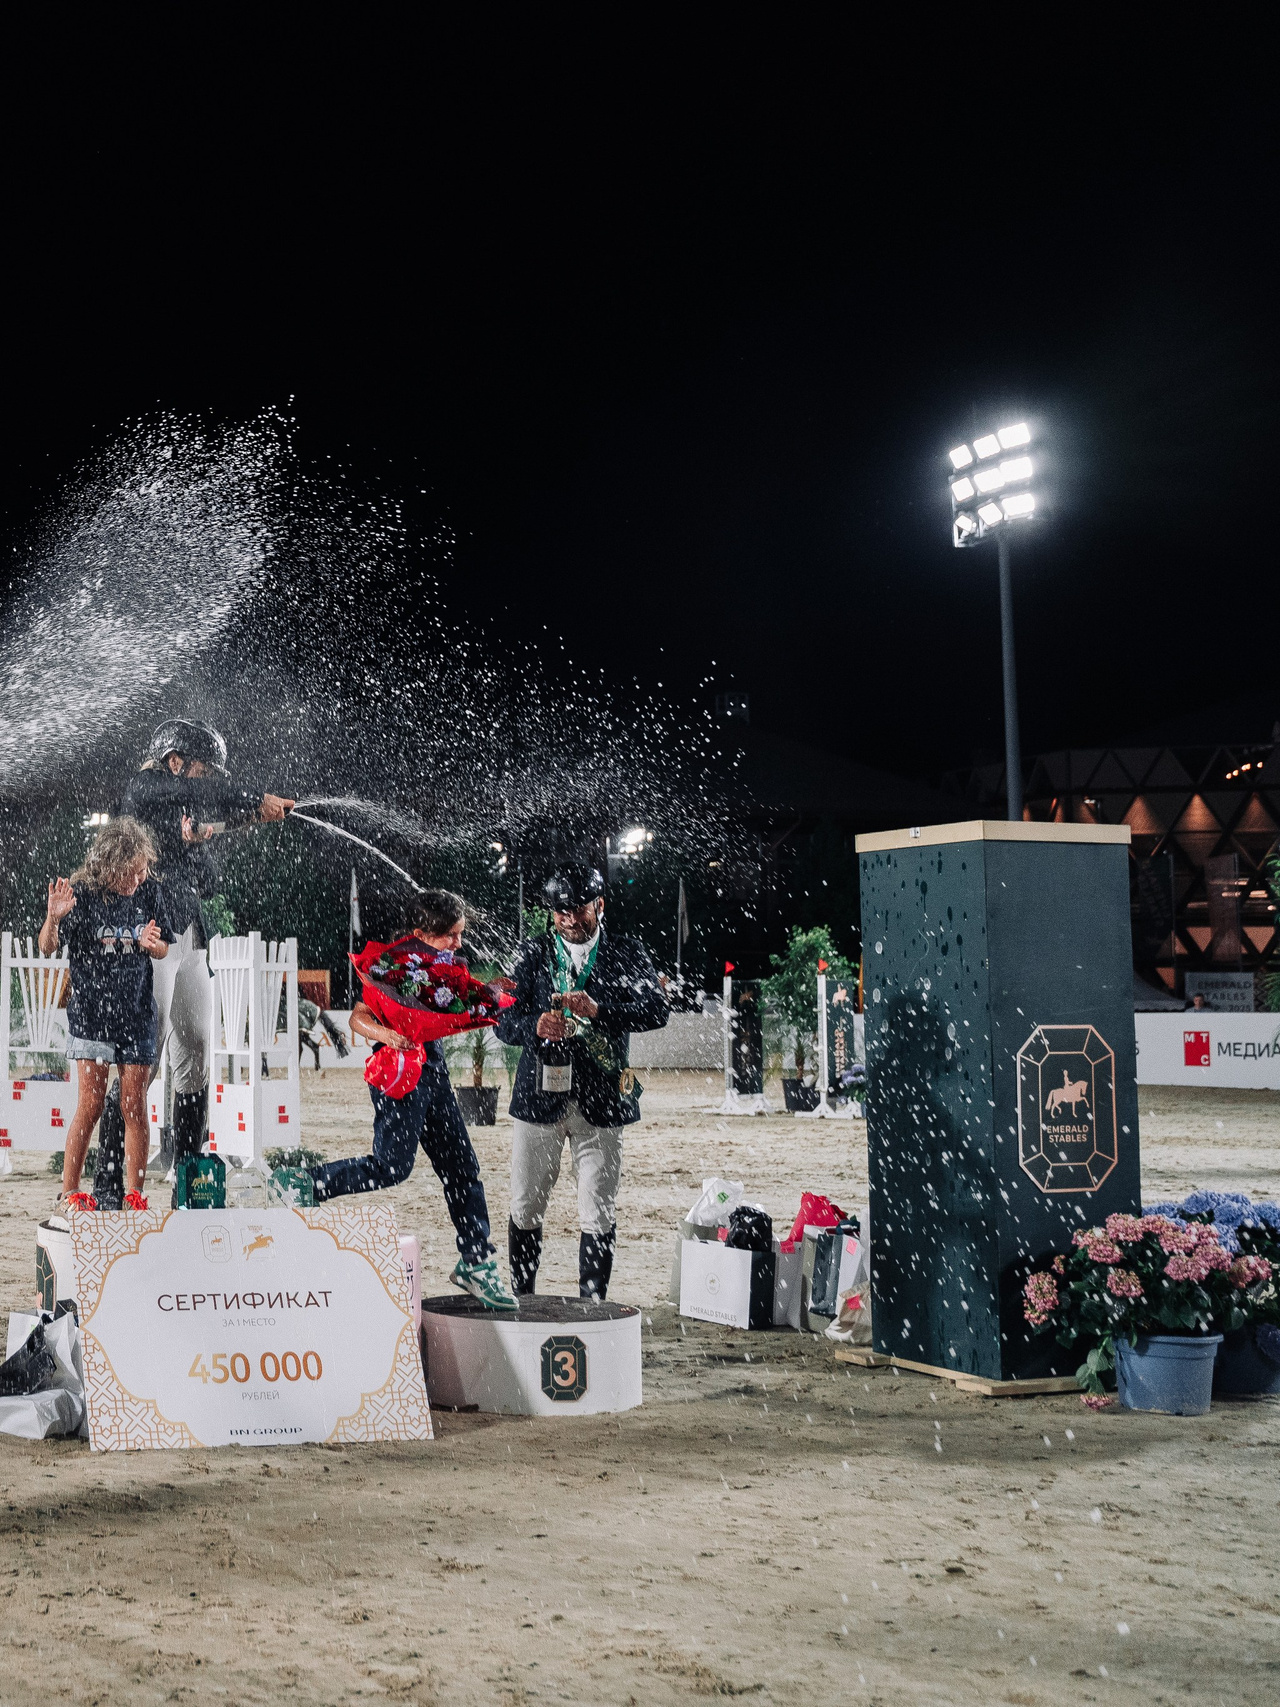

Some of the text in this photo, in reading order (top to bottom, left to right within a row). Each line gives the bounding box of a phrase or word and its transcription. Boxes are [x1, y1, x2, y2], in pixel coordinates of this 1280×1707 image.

[1204, 992, 1246, 1001] TABLES
[1217, 1042, 1280, 1060] МЕДИА
[1046, 1124, 1089, 1133] EMERALD
[1048, 1134, 1088, 1143] STABLES
[157, 1290, 332, 1312] СЕРТИФИКАТ
[689, 1305, 737, 1322] EMERALD STABLES
[242, 1317, 277, 1327] МЕСТО
[188, 1350, 323, 1384] 450 000
[553, 1350, 577, 1387] 3
[241, 1389, 280, 1401] РУБЛЕЙ
[229, 1427, 303, 1436] BN GROUP
